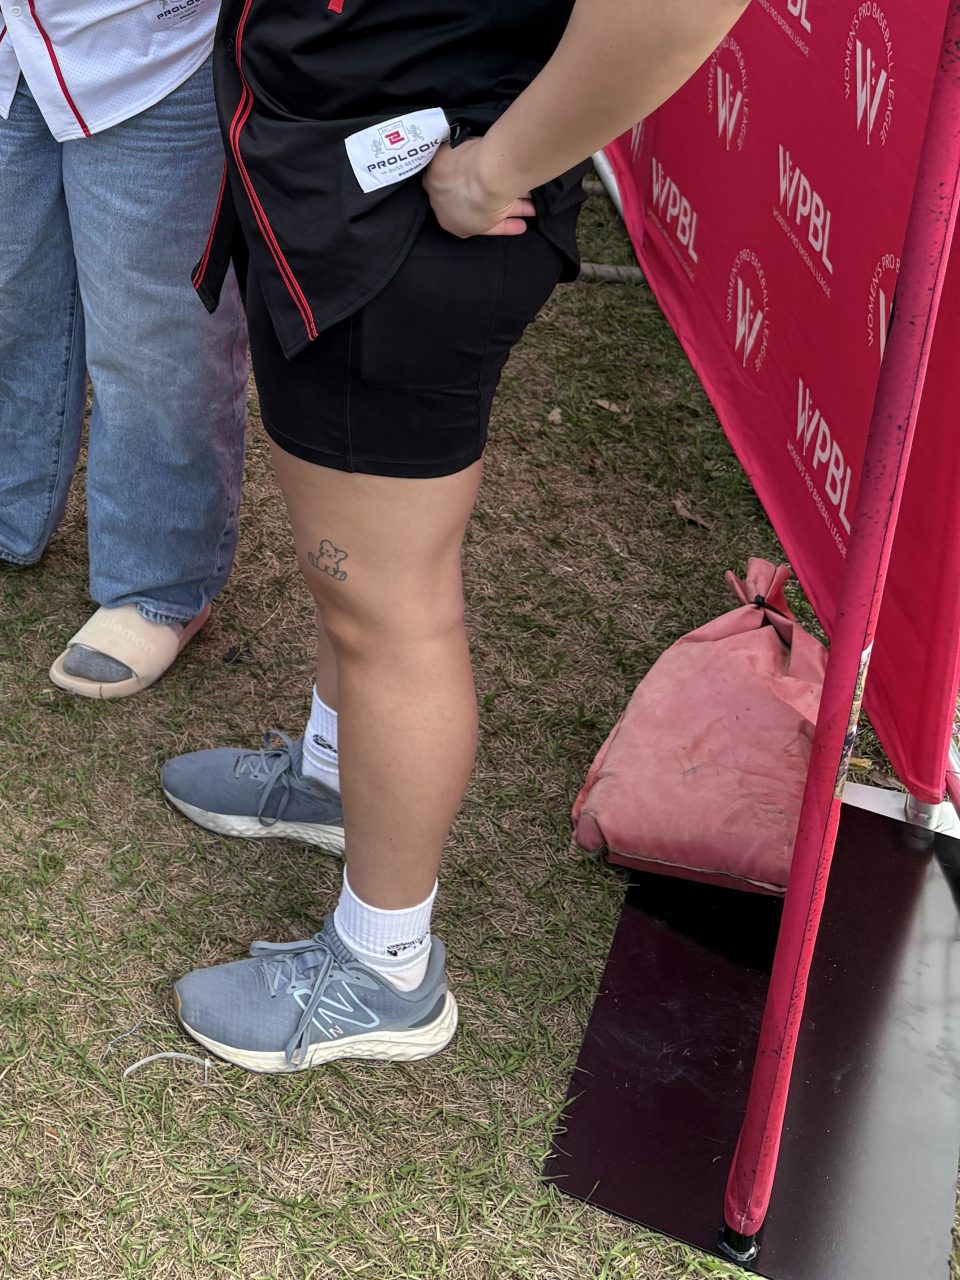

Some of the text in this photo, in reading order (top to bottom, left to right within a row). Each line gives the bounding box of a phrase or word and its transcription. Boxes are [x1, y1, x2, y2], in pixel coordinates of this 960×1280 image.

[844, 1, 894, 146] WOMEN'S PRO BASEBALL LEAGUE
[366, 138, 439, 173] PROLOOK
[652, 157, 698, 264] WPBL
[778, 144, 833, 275] WPBL
[867, 253, 895, 347] WOMEN'S PRO
[796, 376, 851, 536] WPBL
